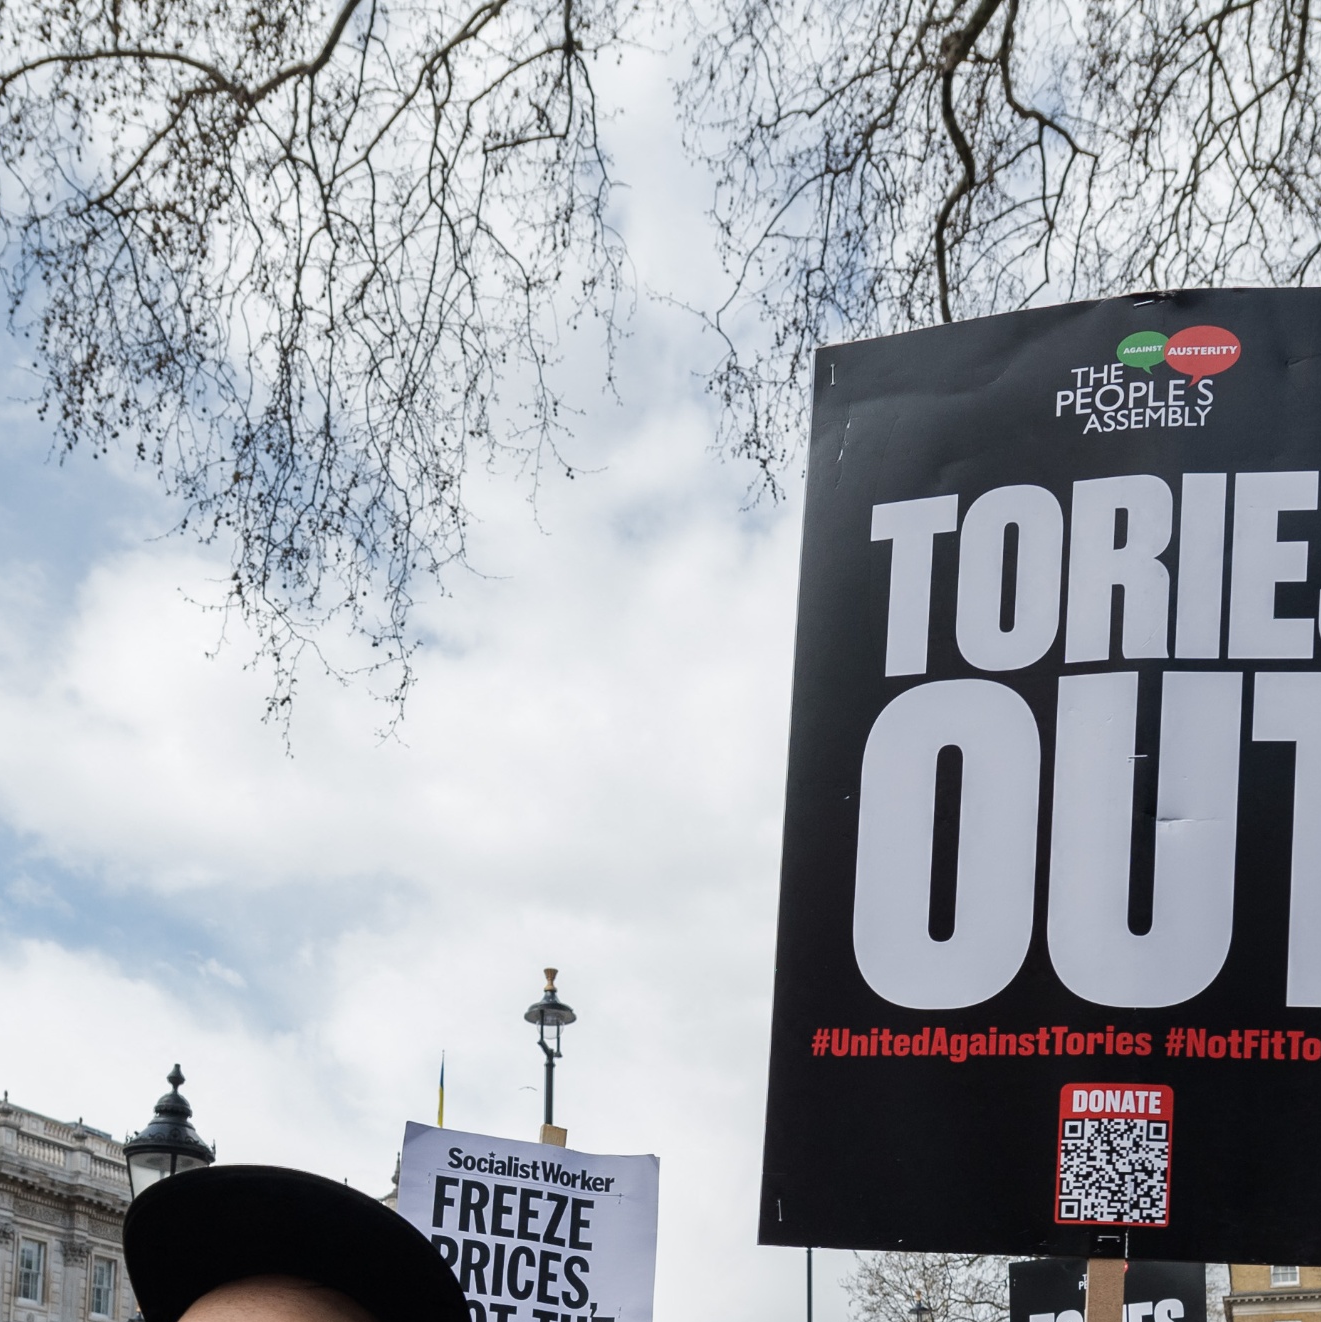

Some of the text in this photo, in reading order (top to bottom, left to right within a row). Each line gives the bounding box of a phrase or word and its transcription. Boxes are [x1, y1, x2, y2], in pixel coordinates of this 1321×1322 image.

[1123, 345, 1238, 356] AGAINST AUSTERITY
[1071, 363, 1124, 388] THE
[1083, 406, 1212, 435] ASSEMBLY
[811, 1024, 1153, 1062] #UnitedAgainstTories
[1071, 1089, 1162, 1115] DONATE
[432, 1175, 595, 1251] FREEZE
